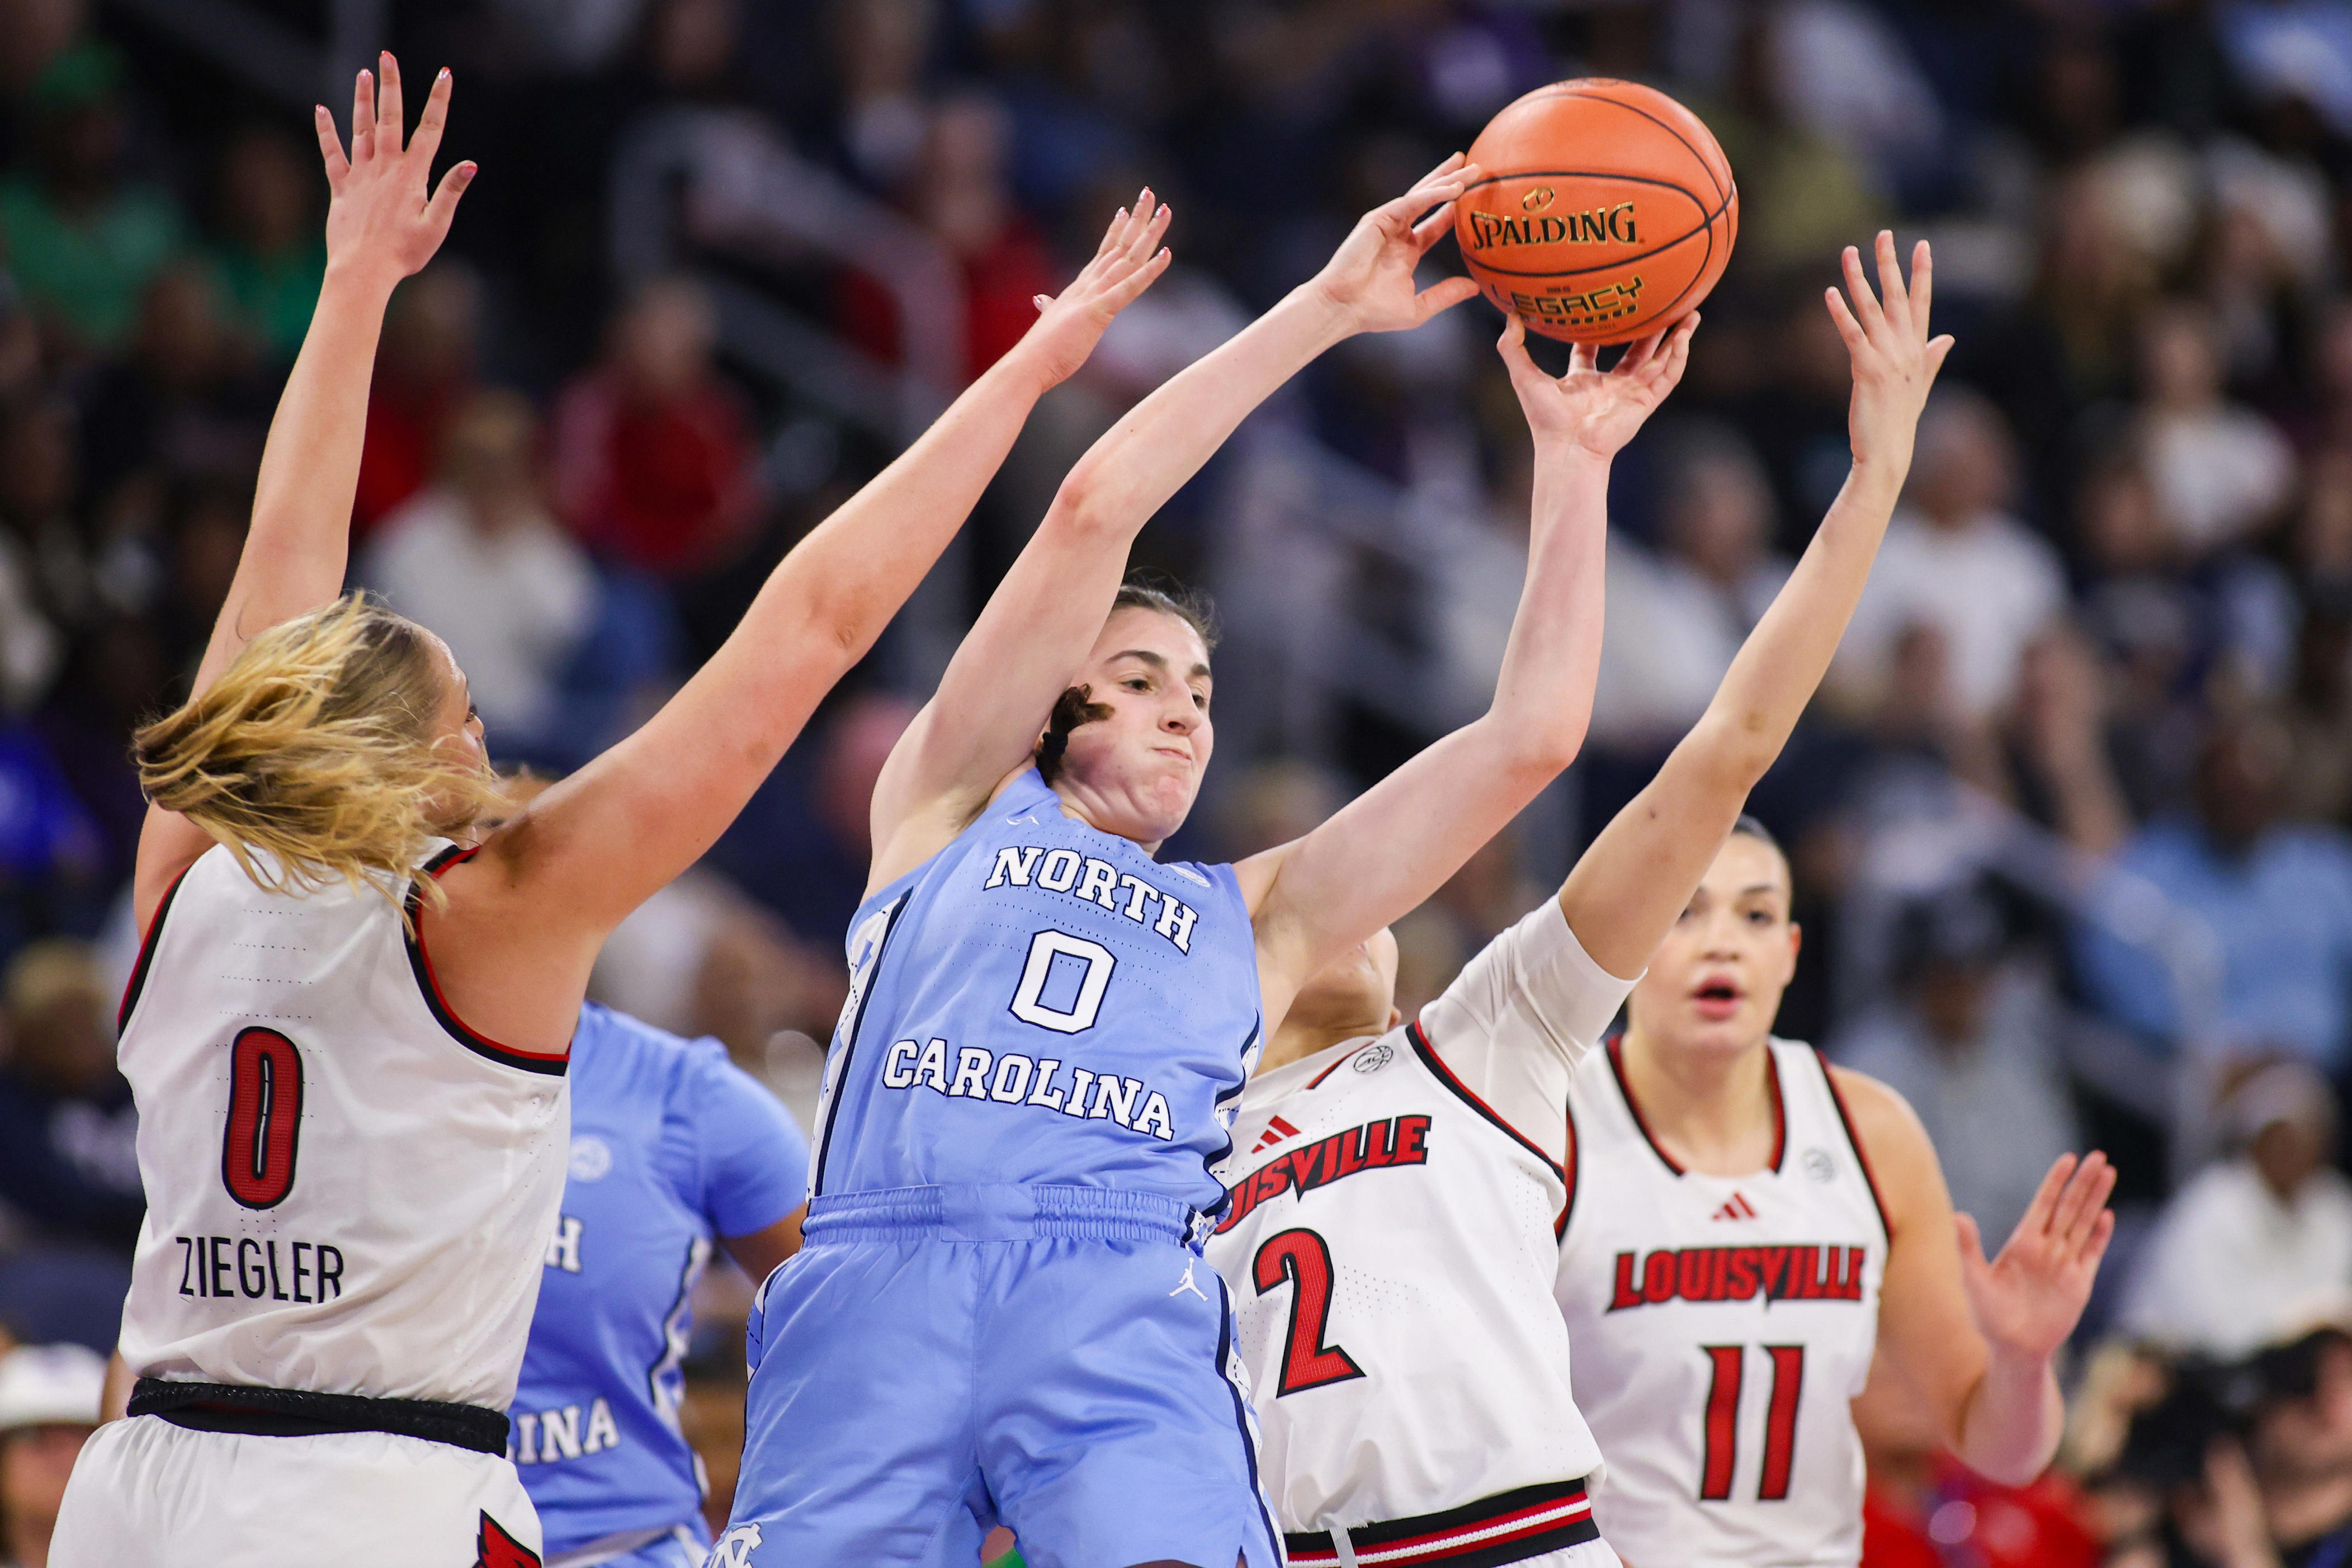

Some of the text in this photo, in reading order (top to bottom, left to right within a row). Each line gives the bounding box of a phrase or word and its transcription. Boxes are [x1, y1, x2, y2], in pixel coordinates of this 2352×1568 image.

[1470, 201, 1636, 251] SPALDING
[1490, 275, 1643, 317] LEGACY
[984, 846, 1199, 955] NORTH
[1008, 928, 1118, 1035] 0
[222, 1026, 304, 1210] 0
[882, 1037, 1175, 1142] CAROLINA
[176, 1235, 345, 1304] ZIEGLER
[1252, 1227, 1367, 1399] 2
[1604, 1245, 1867, 1315] LOUISVILLE
[504, 1396, 621, 1466] INA
[1698, 1344, 1806, 1501] 11
